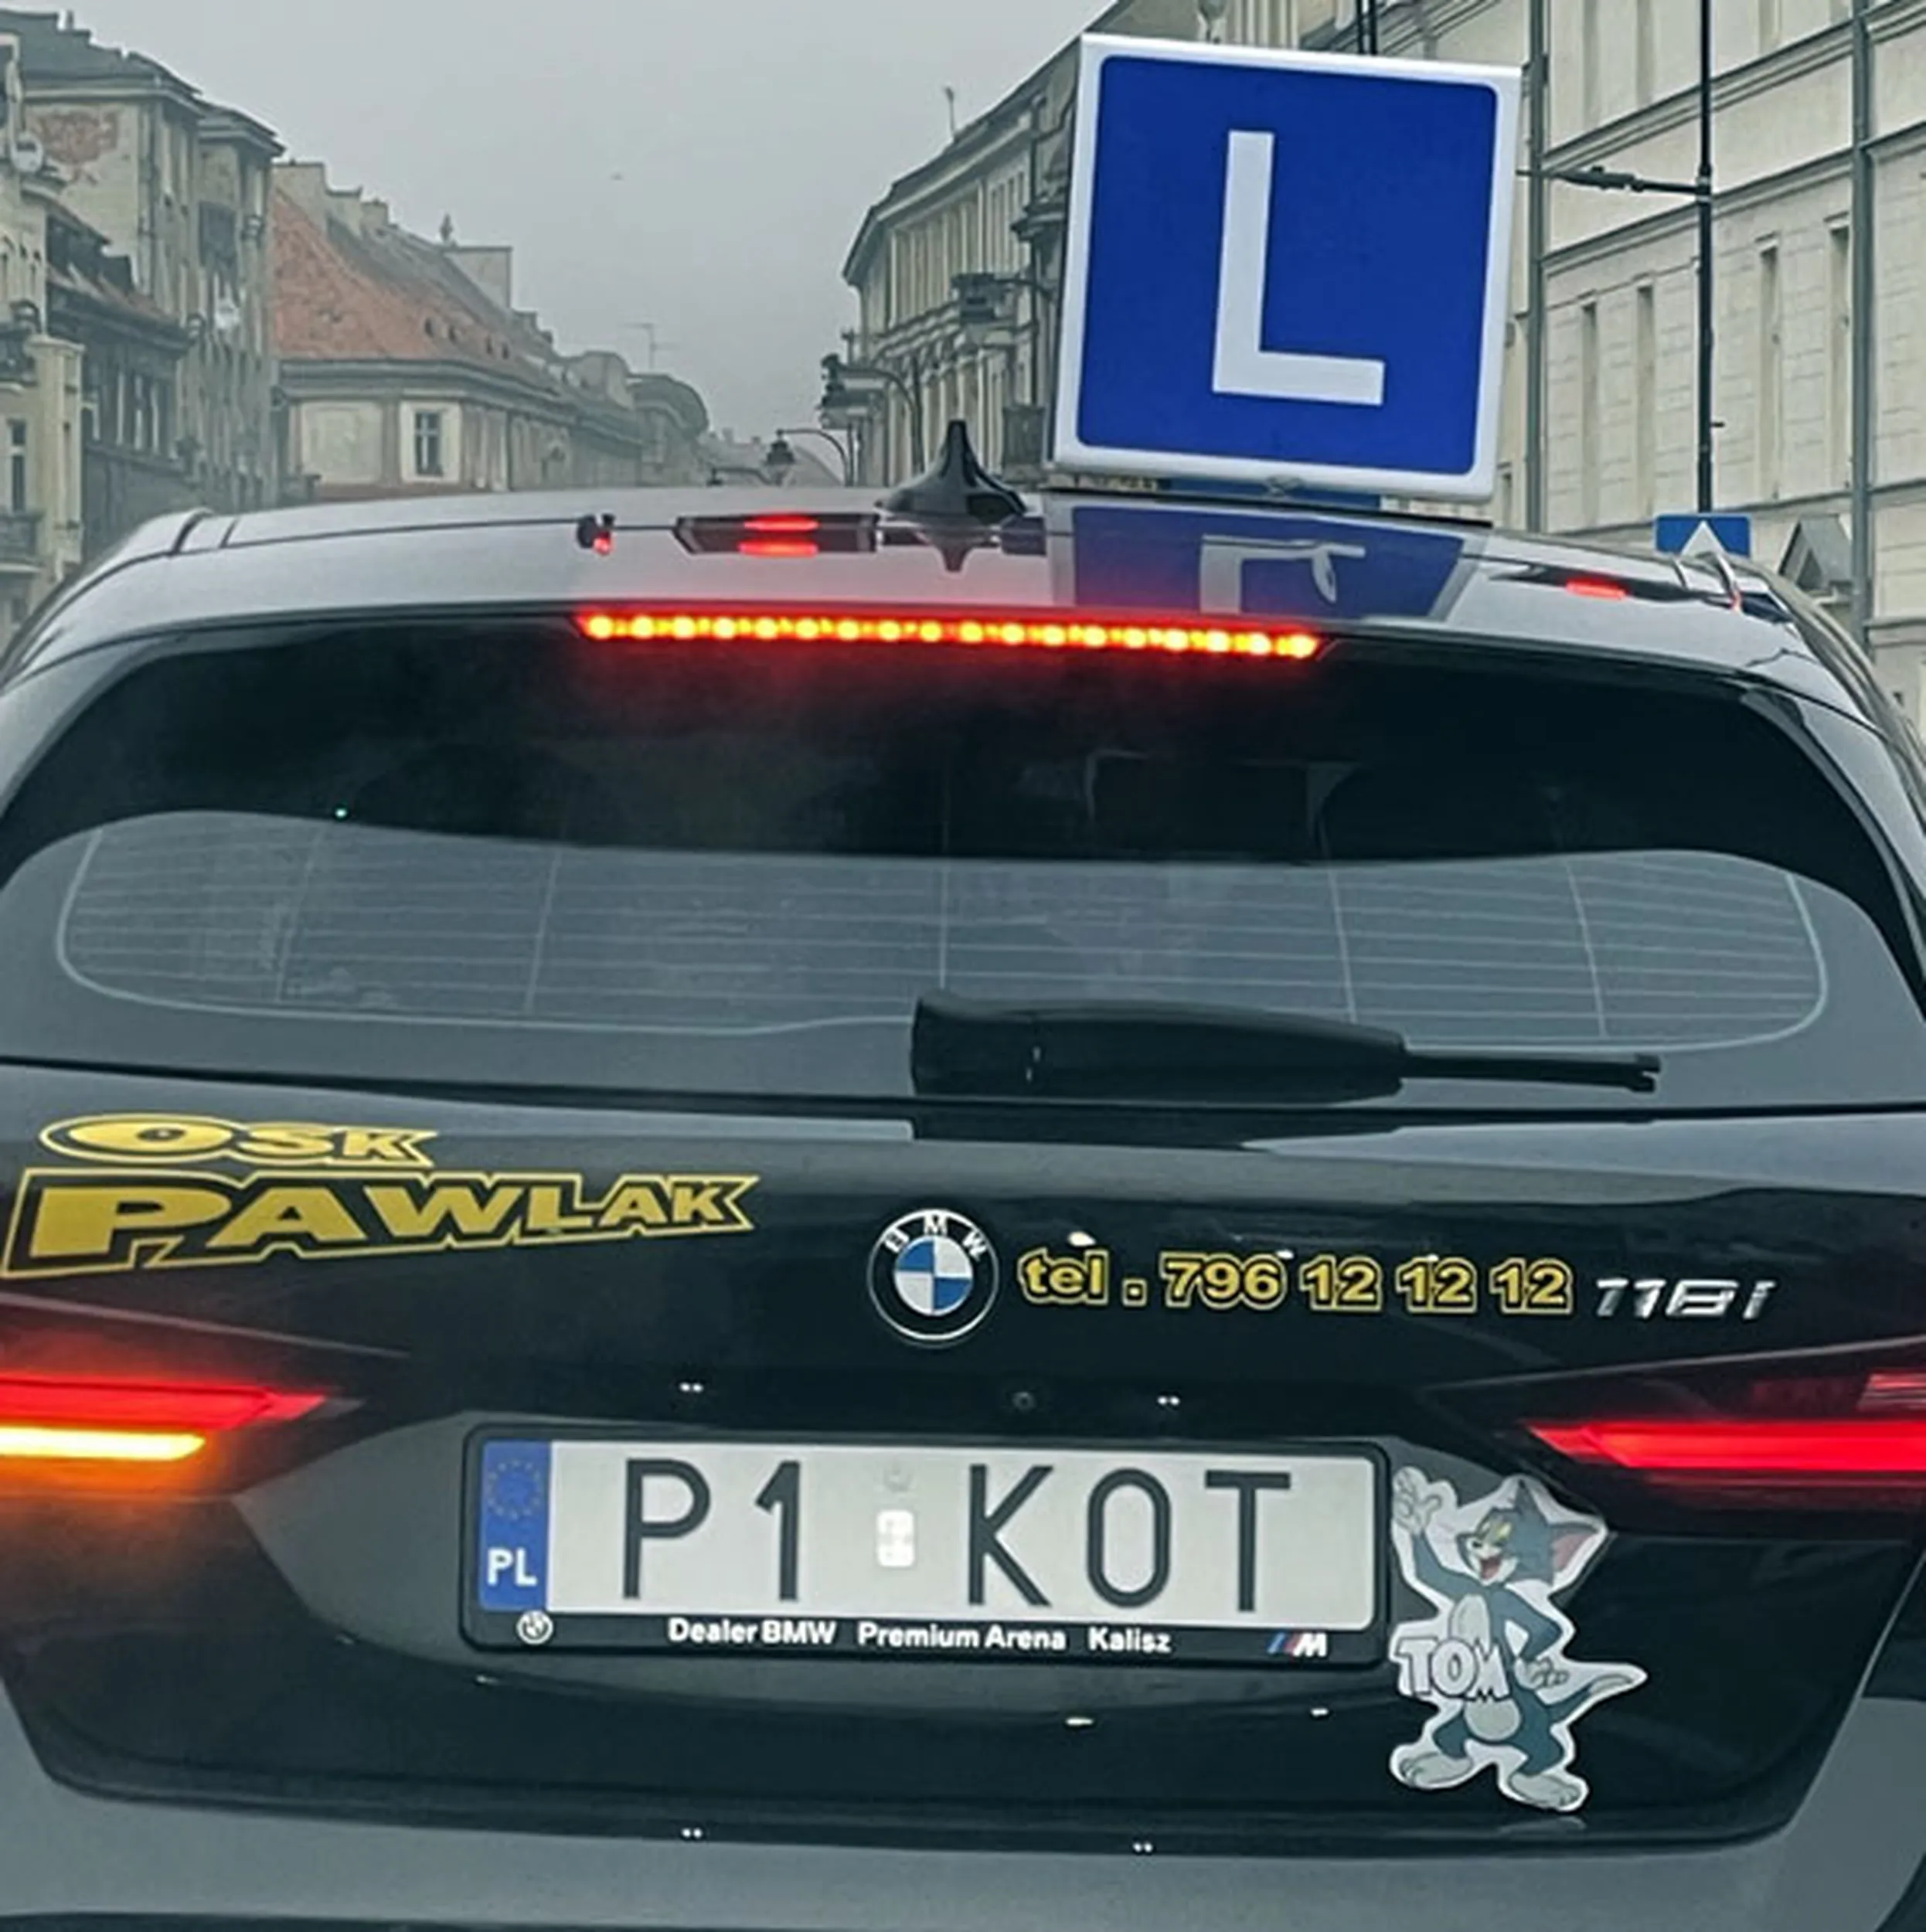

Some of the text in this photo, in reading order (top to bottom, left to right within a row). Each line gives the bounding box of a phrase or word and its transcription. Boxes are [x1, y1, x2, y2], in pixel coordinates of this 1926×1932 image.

[1212, 129, 1386, 406] L
[43, 1114, 434, 1165] OSK
[6, 1169, 756, 1276] PAWLAK
[883, 1213, 988, 1263] BMW
[1019, 1250, 1108, 1304] tel
[1162, 1254, 1285, 1307] 796
[1300, 1256, 1381, 1311] 12
[1397, 1257, 1476, 1313] 12
[1490, 1260, 1574, 1314] 12
[487, 1549, 537, 1586] PL
[623, 1458, 1292, 1613] P1 KOT
[669, 1617, 1172, 1652] Dealer BMW Premium Arena Kalisz
[1396, 1636, 1511, 1702] TOM
